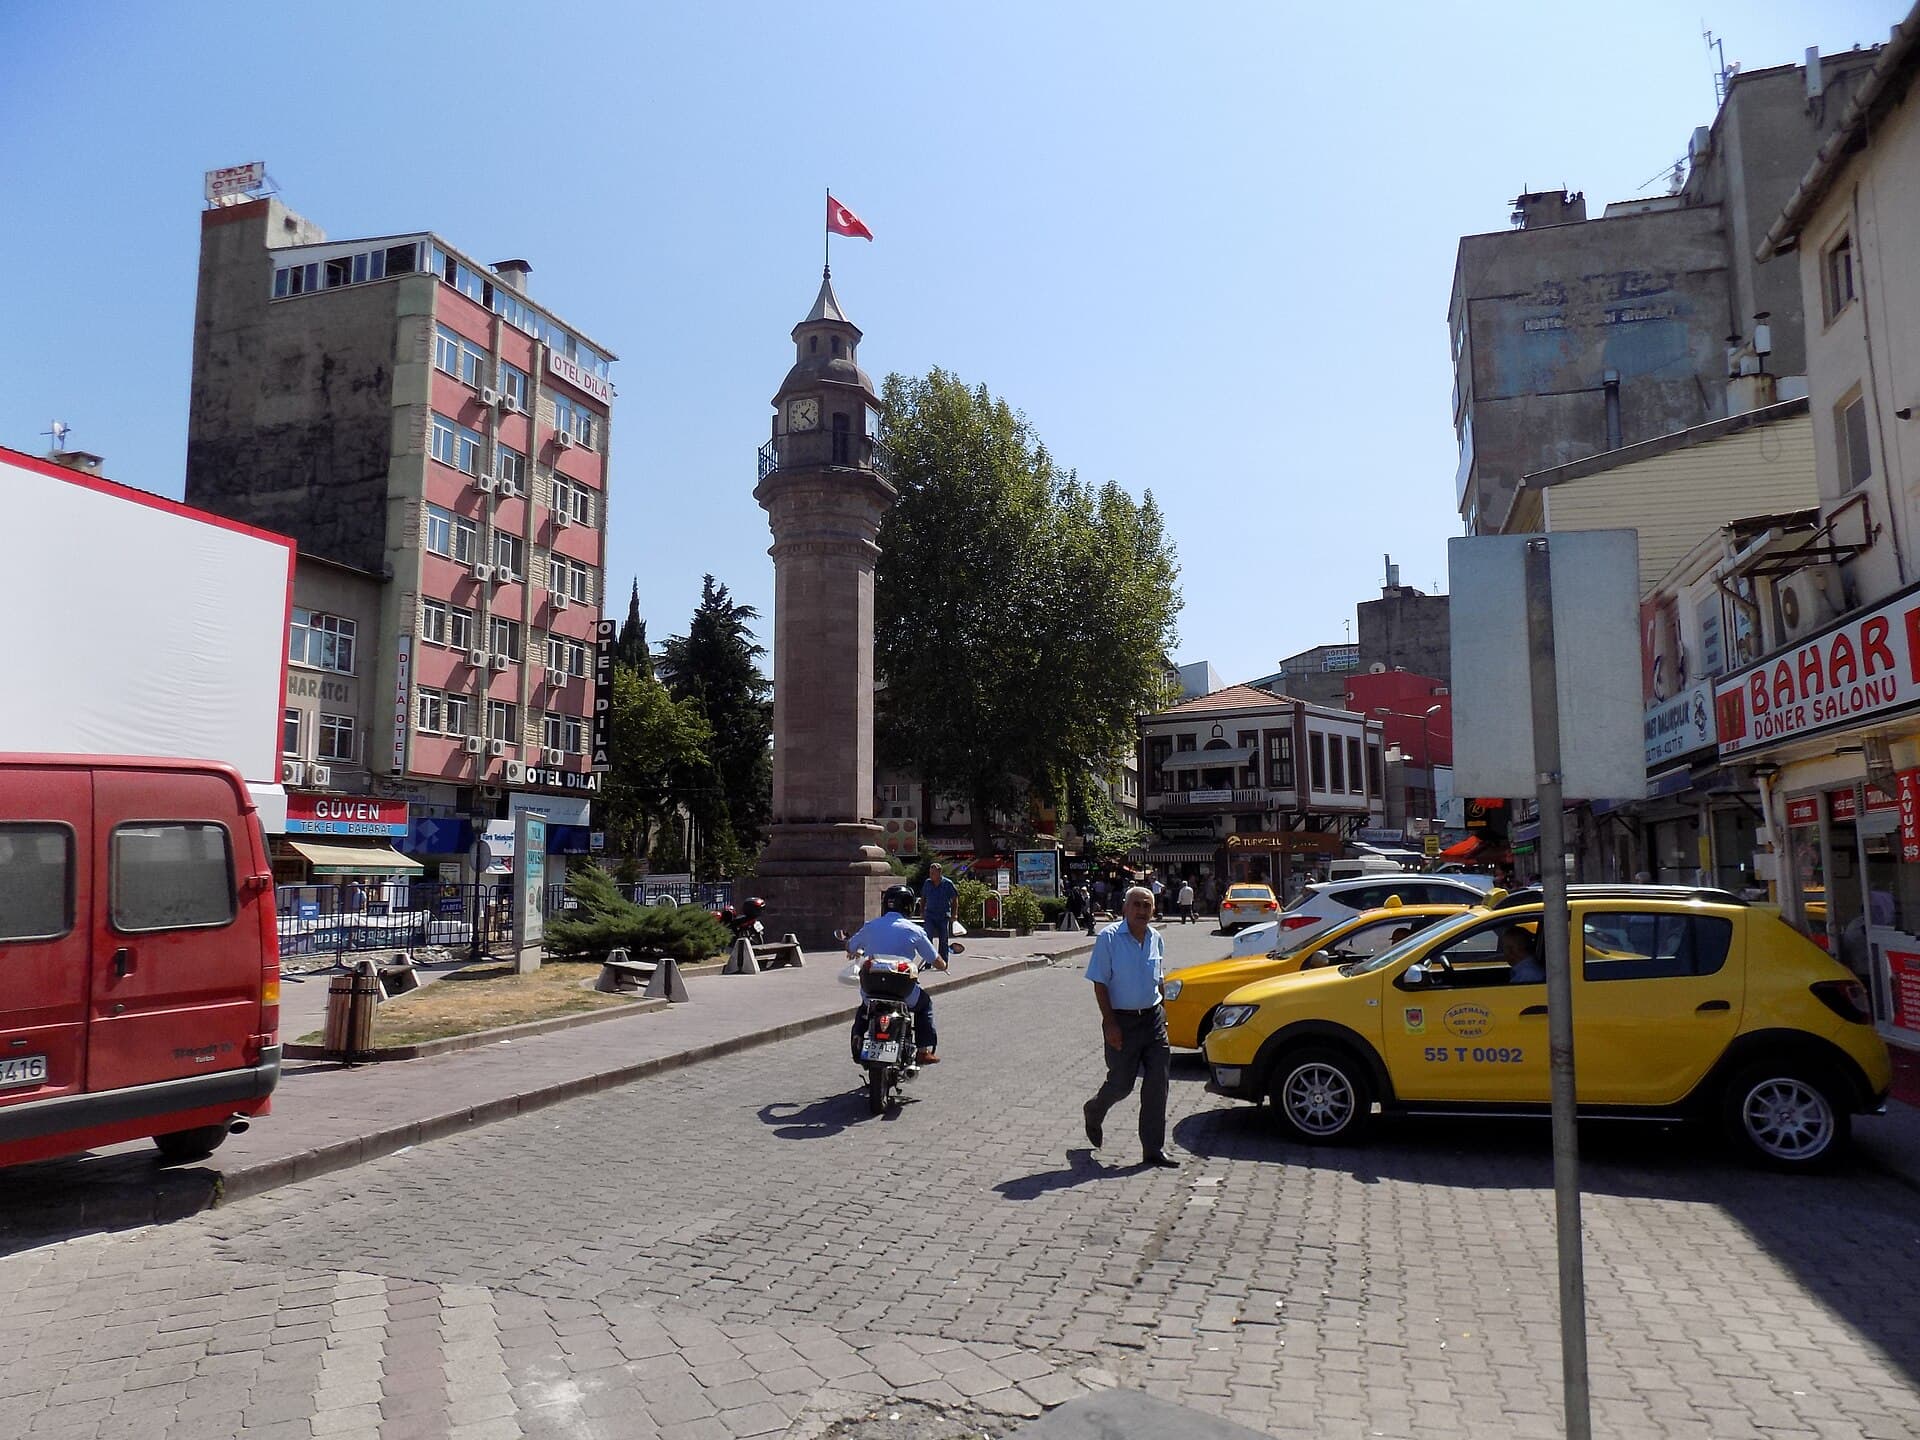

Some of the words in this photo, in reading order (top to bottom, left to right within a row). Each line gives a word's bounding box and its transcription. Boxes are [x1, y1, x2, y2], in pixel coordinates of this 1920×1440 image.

[212, 174, 257, 189] OTEL
[555, 356, 580, 384] OTEL
[598, 622, 611, 686] OTEL
[1751, 615, 1895, 717] BAHAR
[1754, 705, 1806, 740] DÖNER
[1813, 675, 1897, 723] SALONU
[394, 714, 405, 766] OTEL
[527, 767, 562, 786] OTEL
[316, 798, 379, 820] GÜVEN
[1900, 776, 1915, 838] TAVUK
[301, 821, 337, 833] TEK-EL
[348, 823, 392, 833] BAHARAT
[1424, 1048, 1448, 1062] 55
[1455, 1048, 1467, 1062] T
[1472, 1048, 1523, 1062] 0092
[0, 1059, 42, 1081] 416
